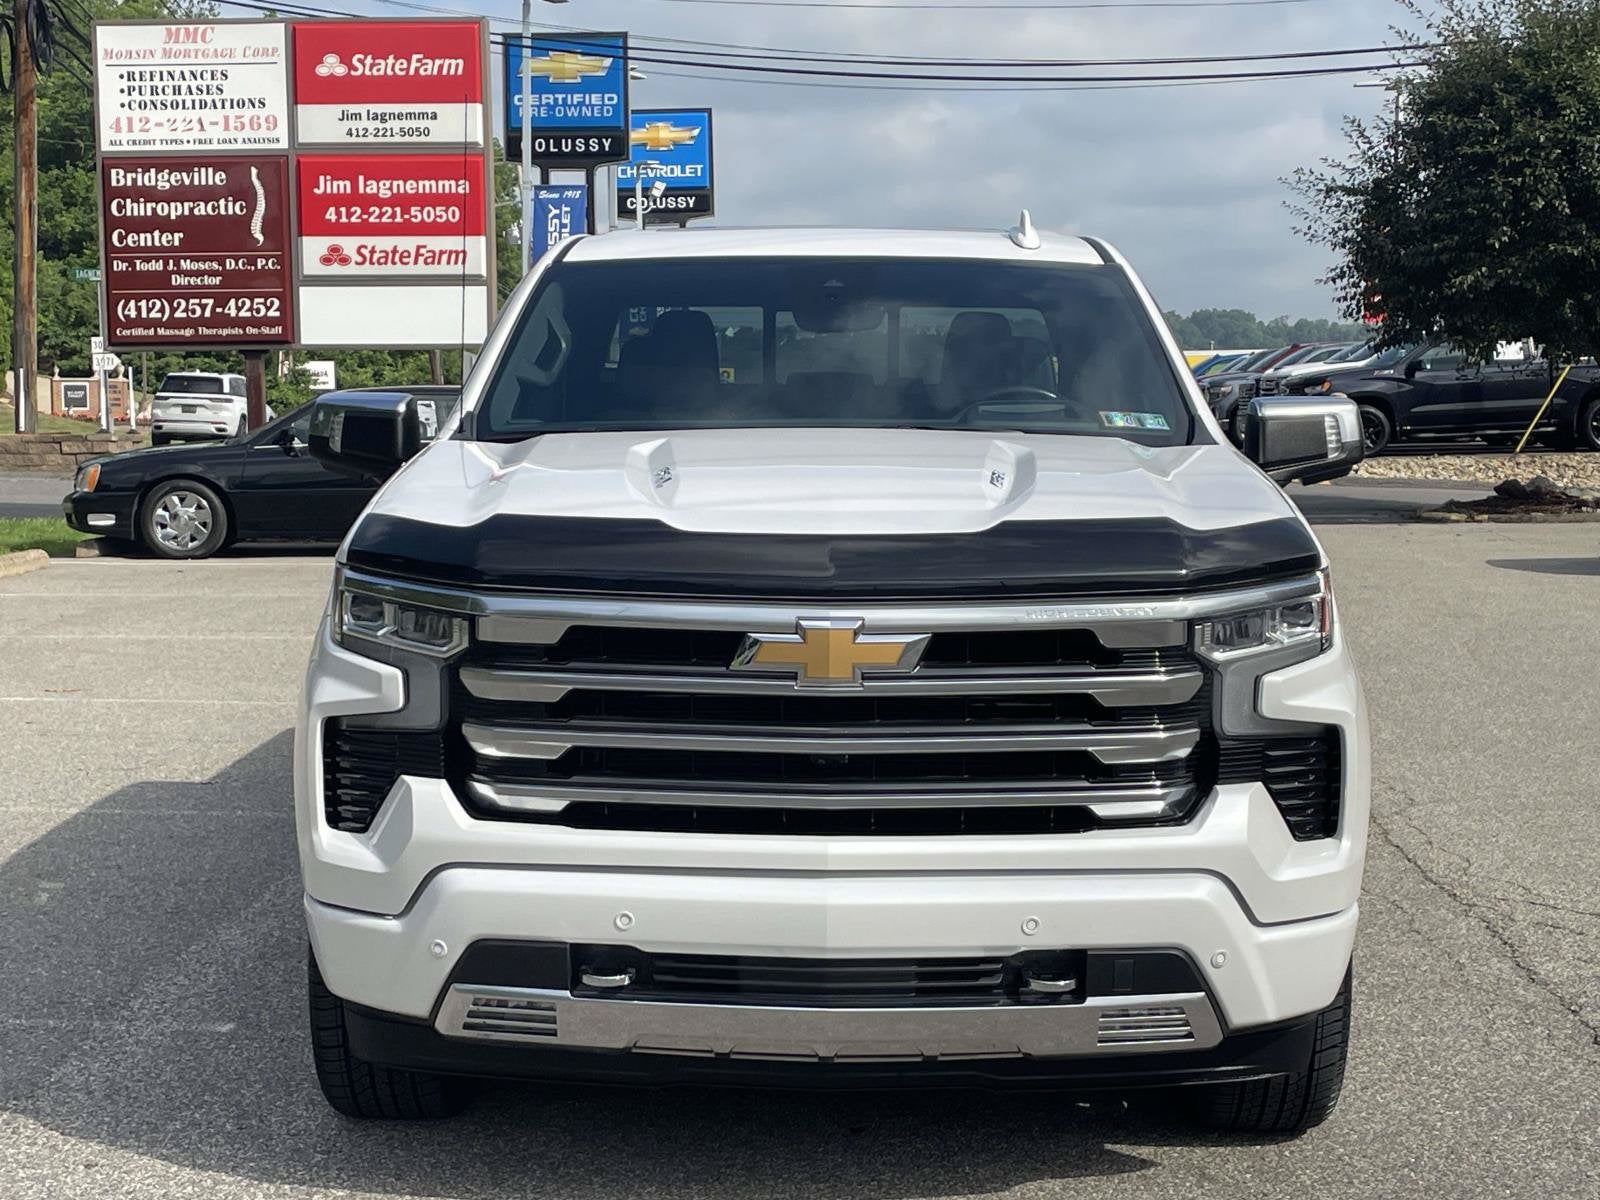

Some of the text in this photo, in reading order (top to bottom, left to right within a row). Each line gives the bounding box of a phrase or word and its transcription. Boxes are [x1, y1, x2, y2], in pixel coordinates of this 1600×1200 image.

[163, 26, 216, 44] MMC
[160, 46, 236, 60] MORTGAGE
[126, 69, 229, 82] REFINANCES
[127, 83, 225, 97] PURCHASES
[127, 97, 267, 111] CONSOLIDATIONS
[337, 109, 438, 124] Jim Iagnemma
[345, 126, 431, 138] 412-221-5050
[108, 136, 281, 147] ALL CREDIT TYPES FREE LOAN ANALYSIS
[520, 138, 612, 152] OLUSSY
[109, 166, 227, 190] Bridgeville
[617, 164, 704, 179] CHEVROLET
[313, 175, 470, 199] Jim Iagnemma
[110, 196, 247, 219] Chiropractic
[325, 205, 461, 223] 412-221-5050
[111, 228, 184, 247] Center
[113, 259, 132, 272] Dr.
[134, 259, 164, 271] Todd
[166, 259, 178, 271] J.
[180, 258, 223, 271] Moses,
[256, 257, 281, 270] P.C.
[171, 274, 223, 286] Director
[116, 297, 281, 322] (412) 257-4252
[116, 325, 283, 337] Certified Massage Therapists On-Staff
